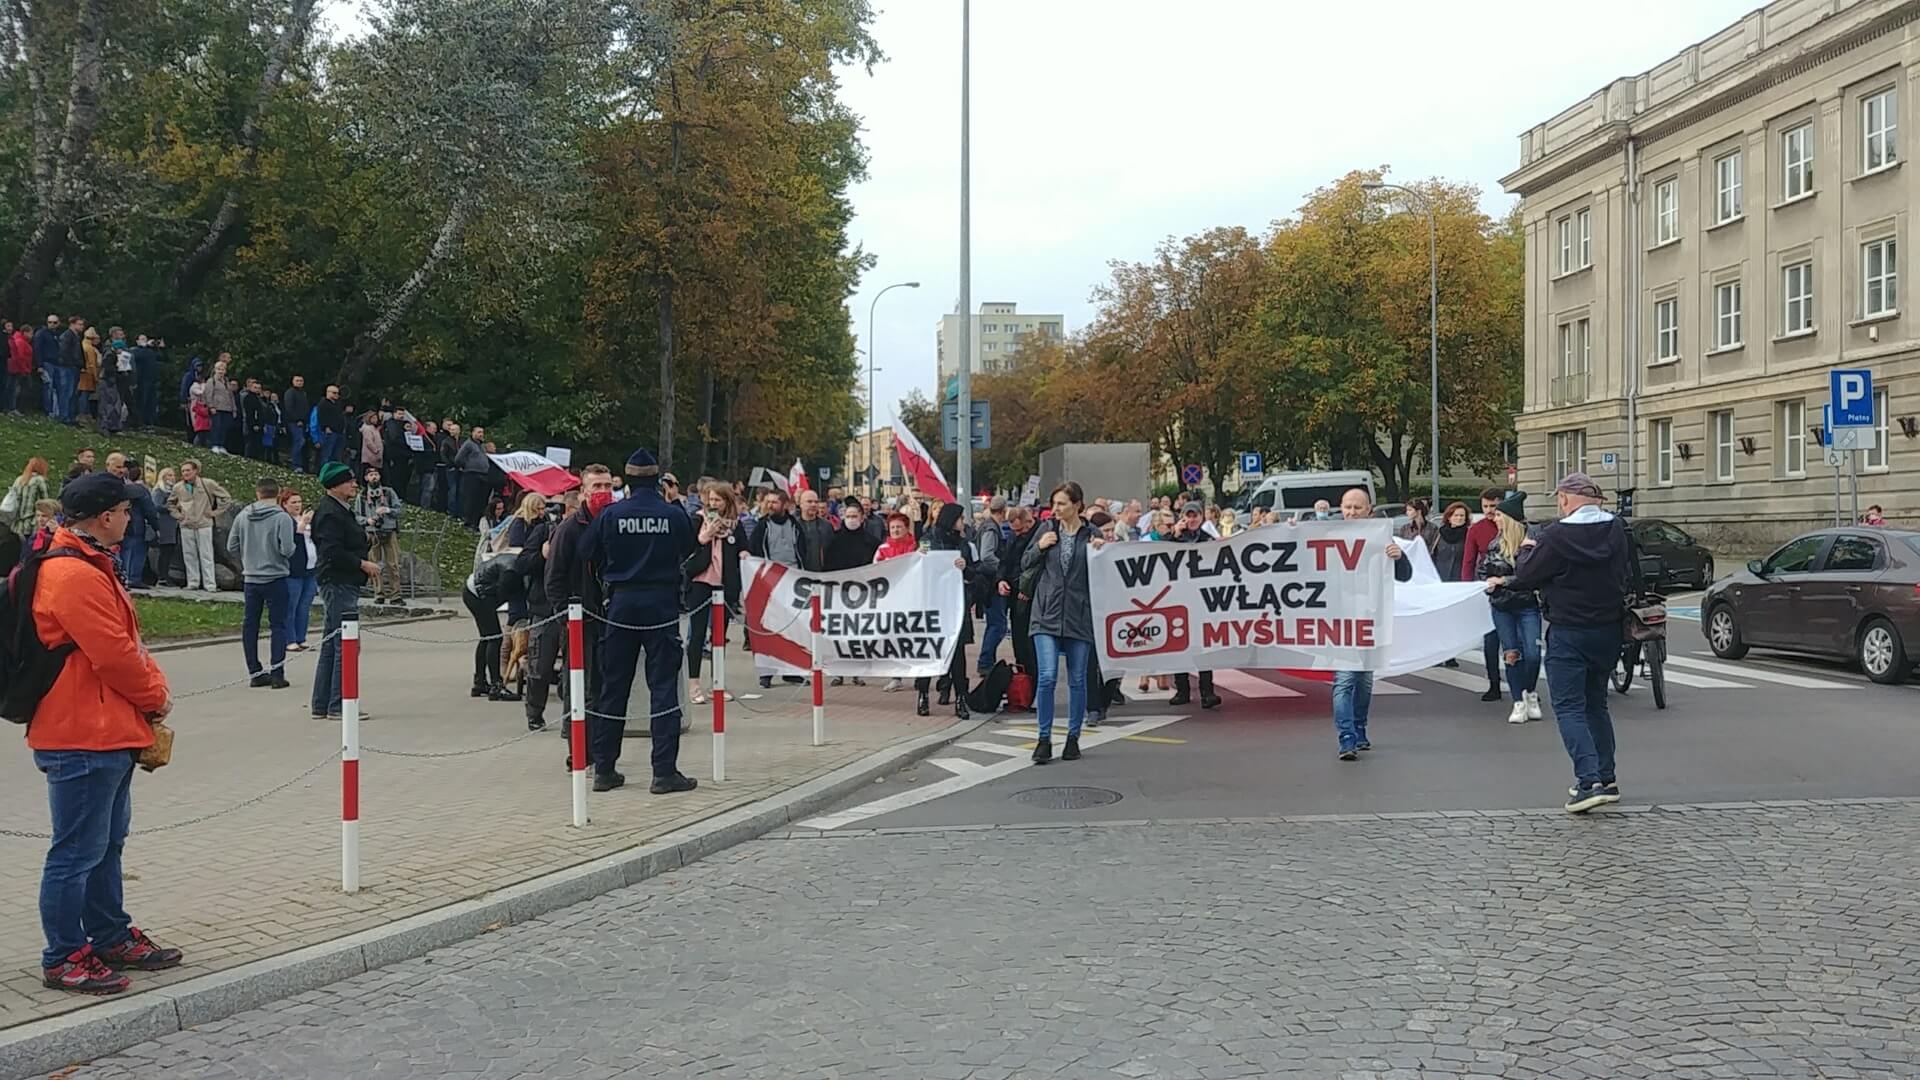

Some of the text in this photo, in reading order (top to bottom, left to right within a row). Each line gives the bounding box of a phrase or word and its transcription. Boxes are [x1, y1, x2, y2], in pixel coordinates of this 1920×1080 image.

[1840, 374, 1864, 410] P
[1245, 455, 1257, 471] P
[618, 517, 670, 534] POLICJA
[1115, 539, 1366, 588] WYŁĄCZ TV
[791, 576, 890, 610] STOP
[1199, 581, 1327, 616] WŁĄCZ
[1117, 626, 1161, 639] COVID
[1202, 613, 1375, 648] MYŚLENIE
[834, 637, 945, 660] LEKARZY
